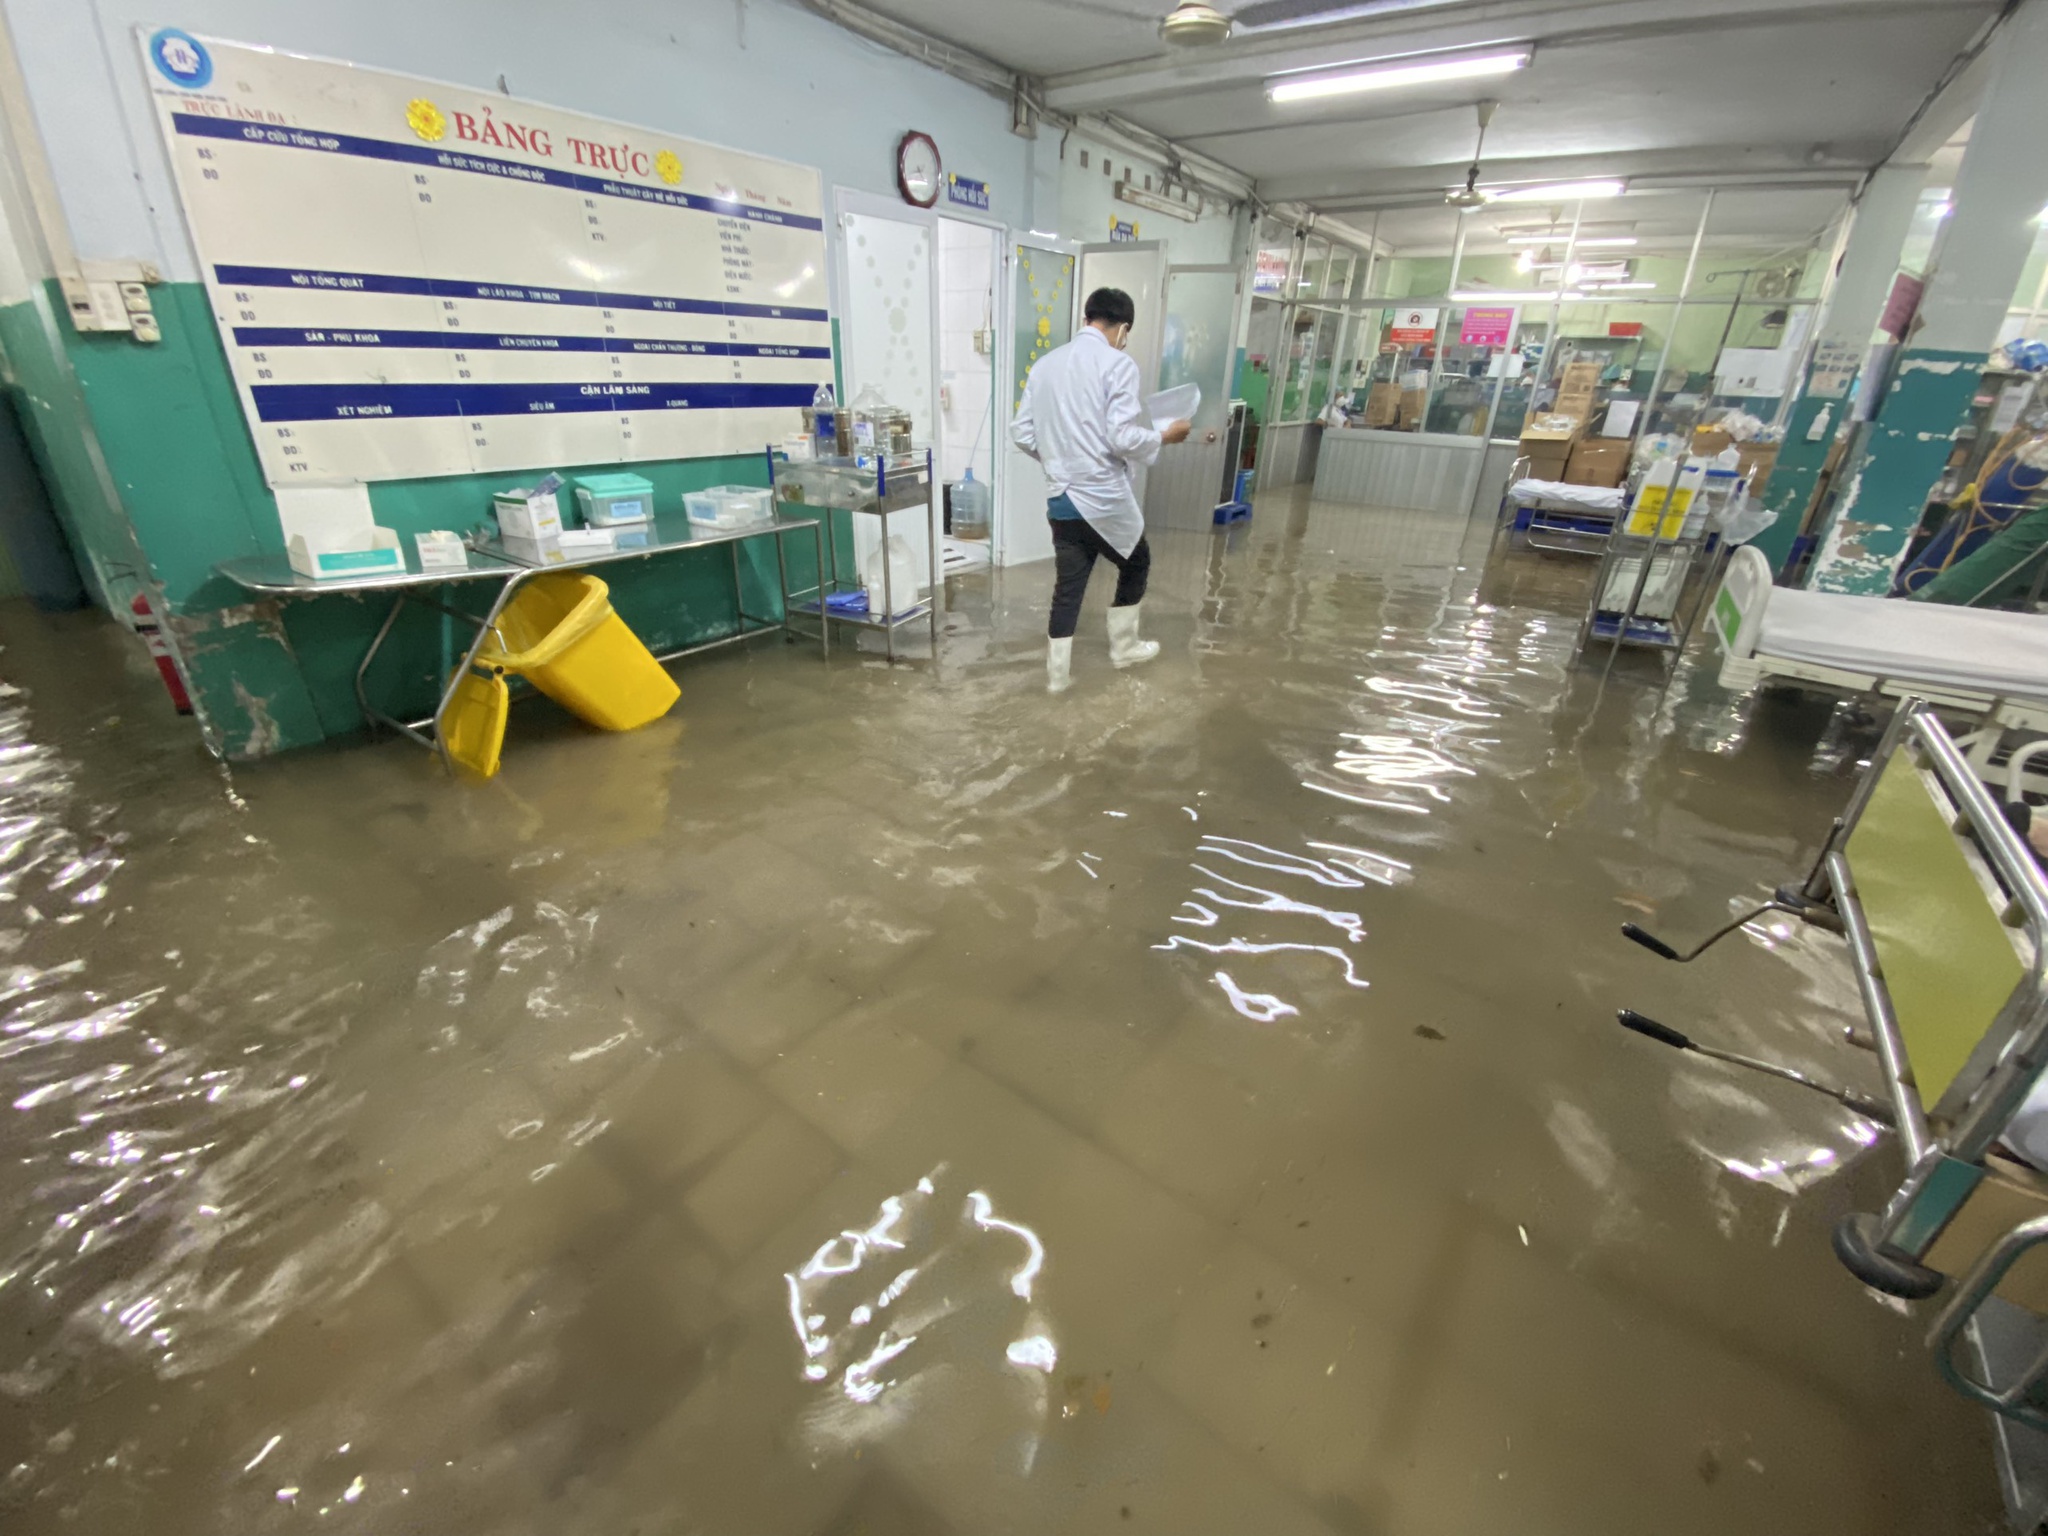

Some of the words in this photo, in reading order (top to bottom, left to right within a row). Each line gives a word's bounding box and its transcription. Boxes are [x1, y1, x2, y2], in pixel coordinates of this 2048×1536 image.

[242, 125, 264, 141] CẤP
[290, 131, 318, 147] TỔNG
[451, 105, 552, 157] BẢNG
[567, 136, 650, 179] TRỰC
[311, 272, 338, 287] TỔNG
[355, 333, 380, 343] KHOA
[580, 385, 600, 397] CẬN
[336, 405, 355, 416] XÉT
